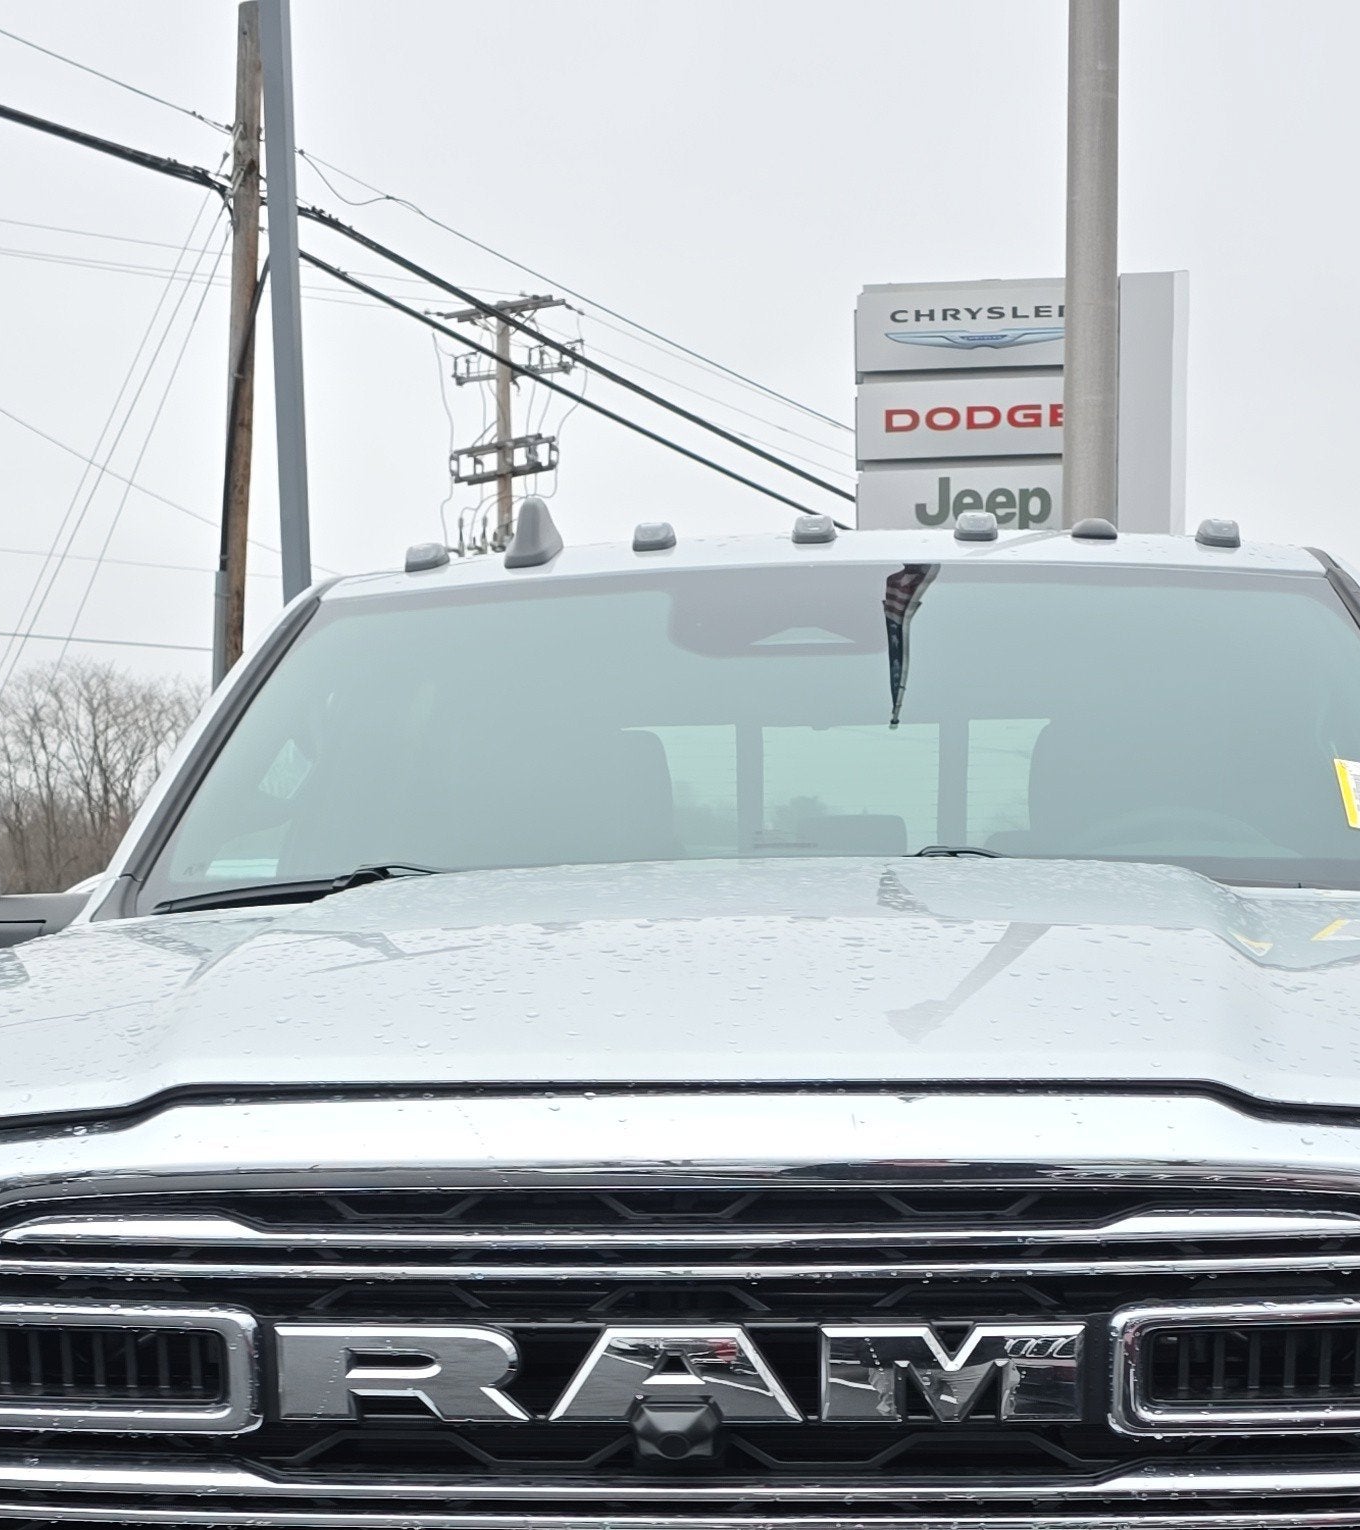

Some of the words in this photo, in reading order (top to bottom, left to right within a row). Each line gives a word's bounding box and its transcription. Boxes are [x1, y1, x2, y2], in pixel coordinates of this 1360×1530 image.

[889, 304, 1065, 323] CHRYSLE
[915, 476, 1052, 529] Jeep
[271, 1322, 1087, 1423] RAM
